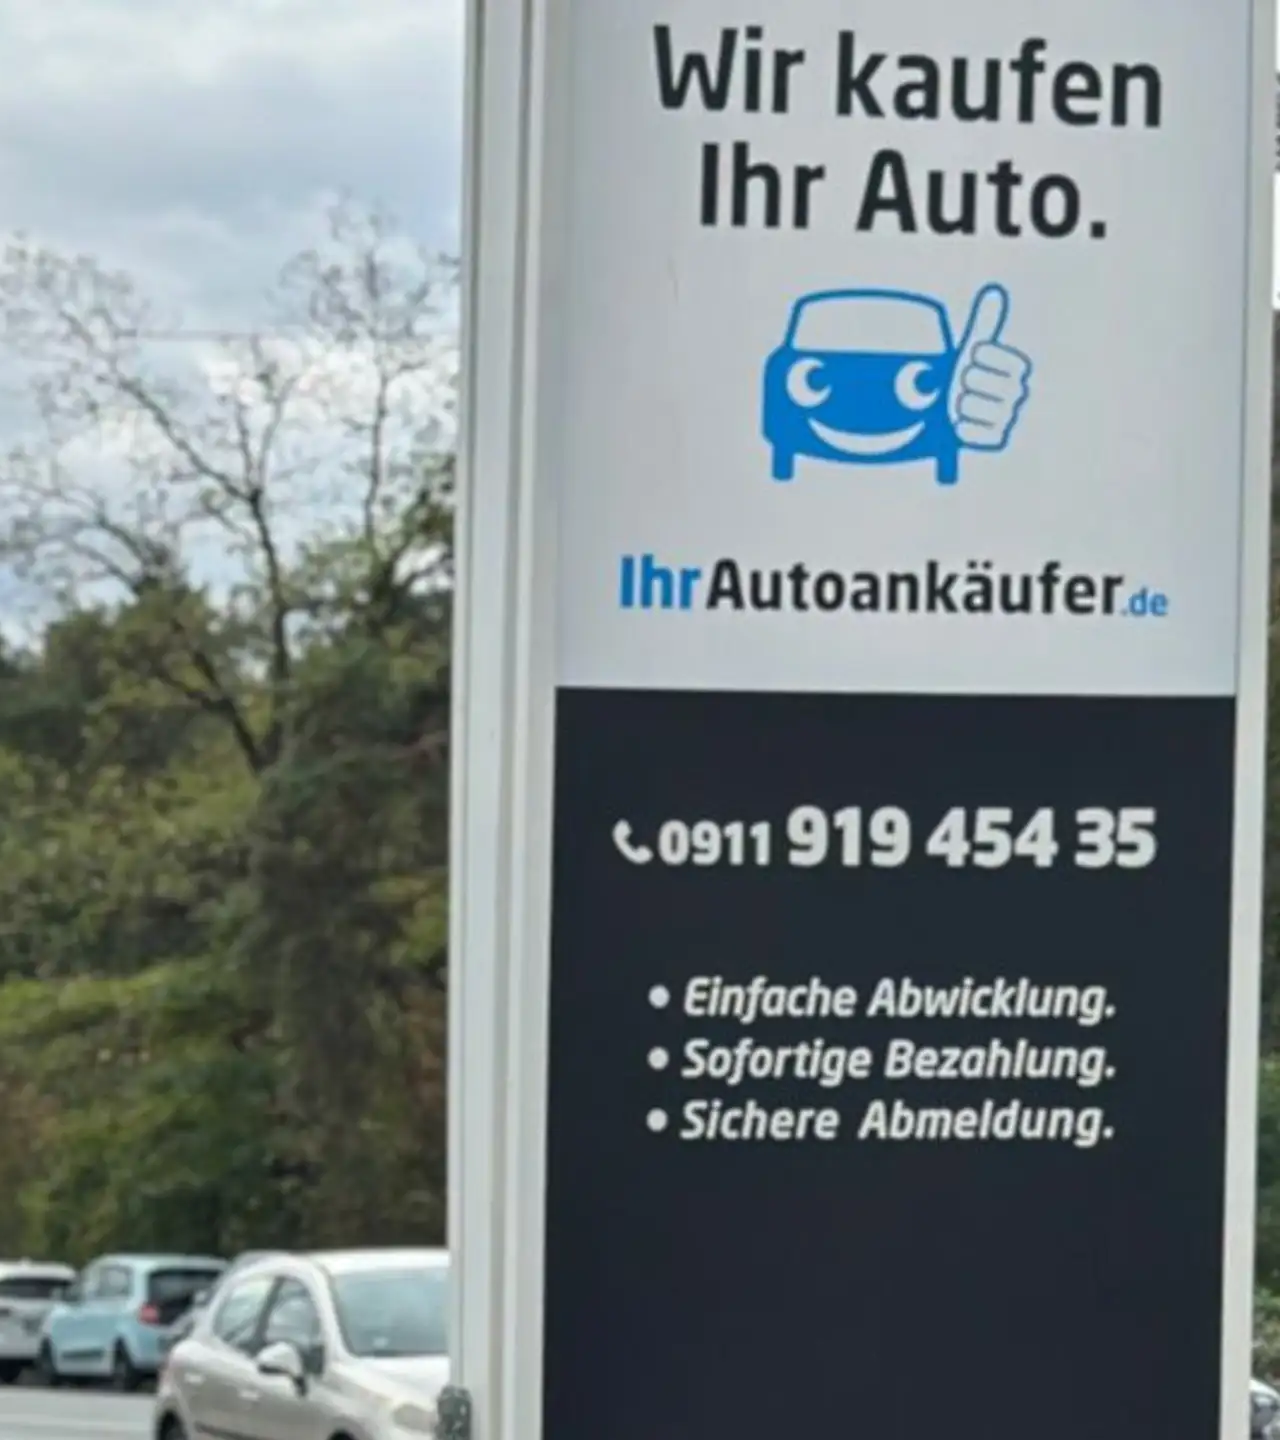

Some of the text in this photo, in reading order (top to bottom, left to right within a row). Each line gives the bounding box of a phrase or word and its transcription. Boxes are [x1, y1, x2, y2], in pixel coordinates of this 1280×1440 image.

[653, 24, 1162, 128] Wir kaufen
[700, 141, 1107, 239] Ihr Auto.
[658, 805, 1158, 868] 0911 919 454 35
[683, 975, 1116, 1026] Einfache Abwicklung.
[680, 1037, 1116, 1087] Sofortige Bezahlung.
[679, 1099, 1114, 1148] Sichere Abmeldung.
